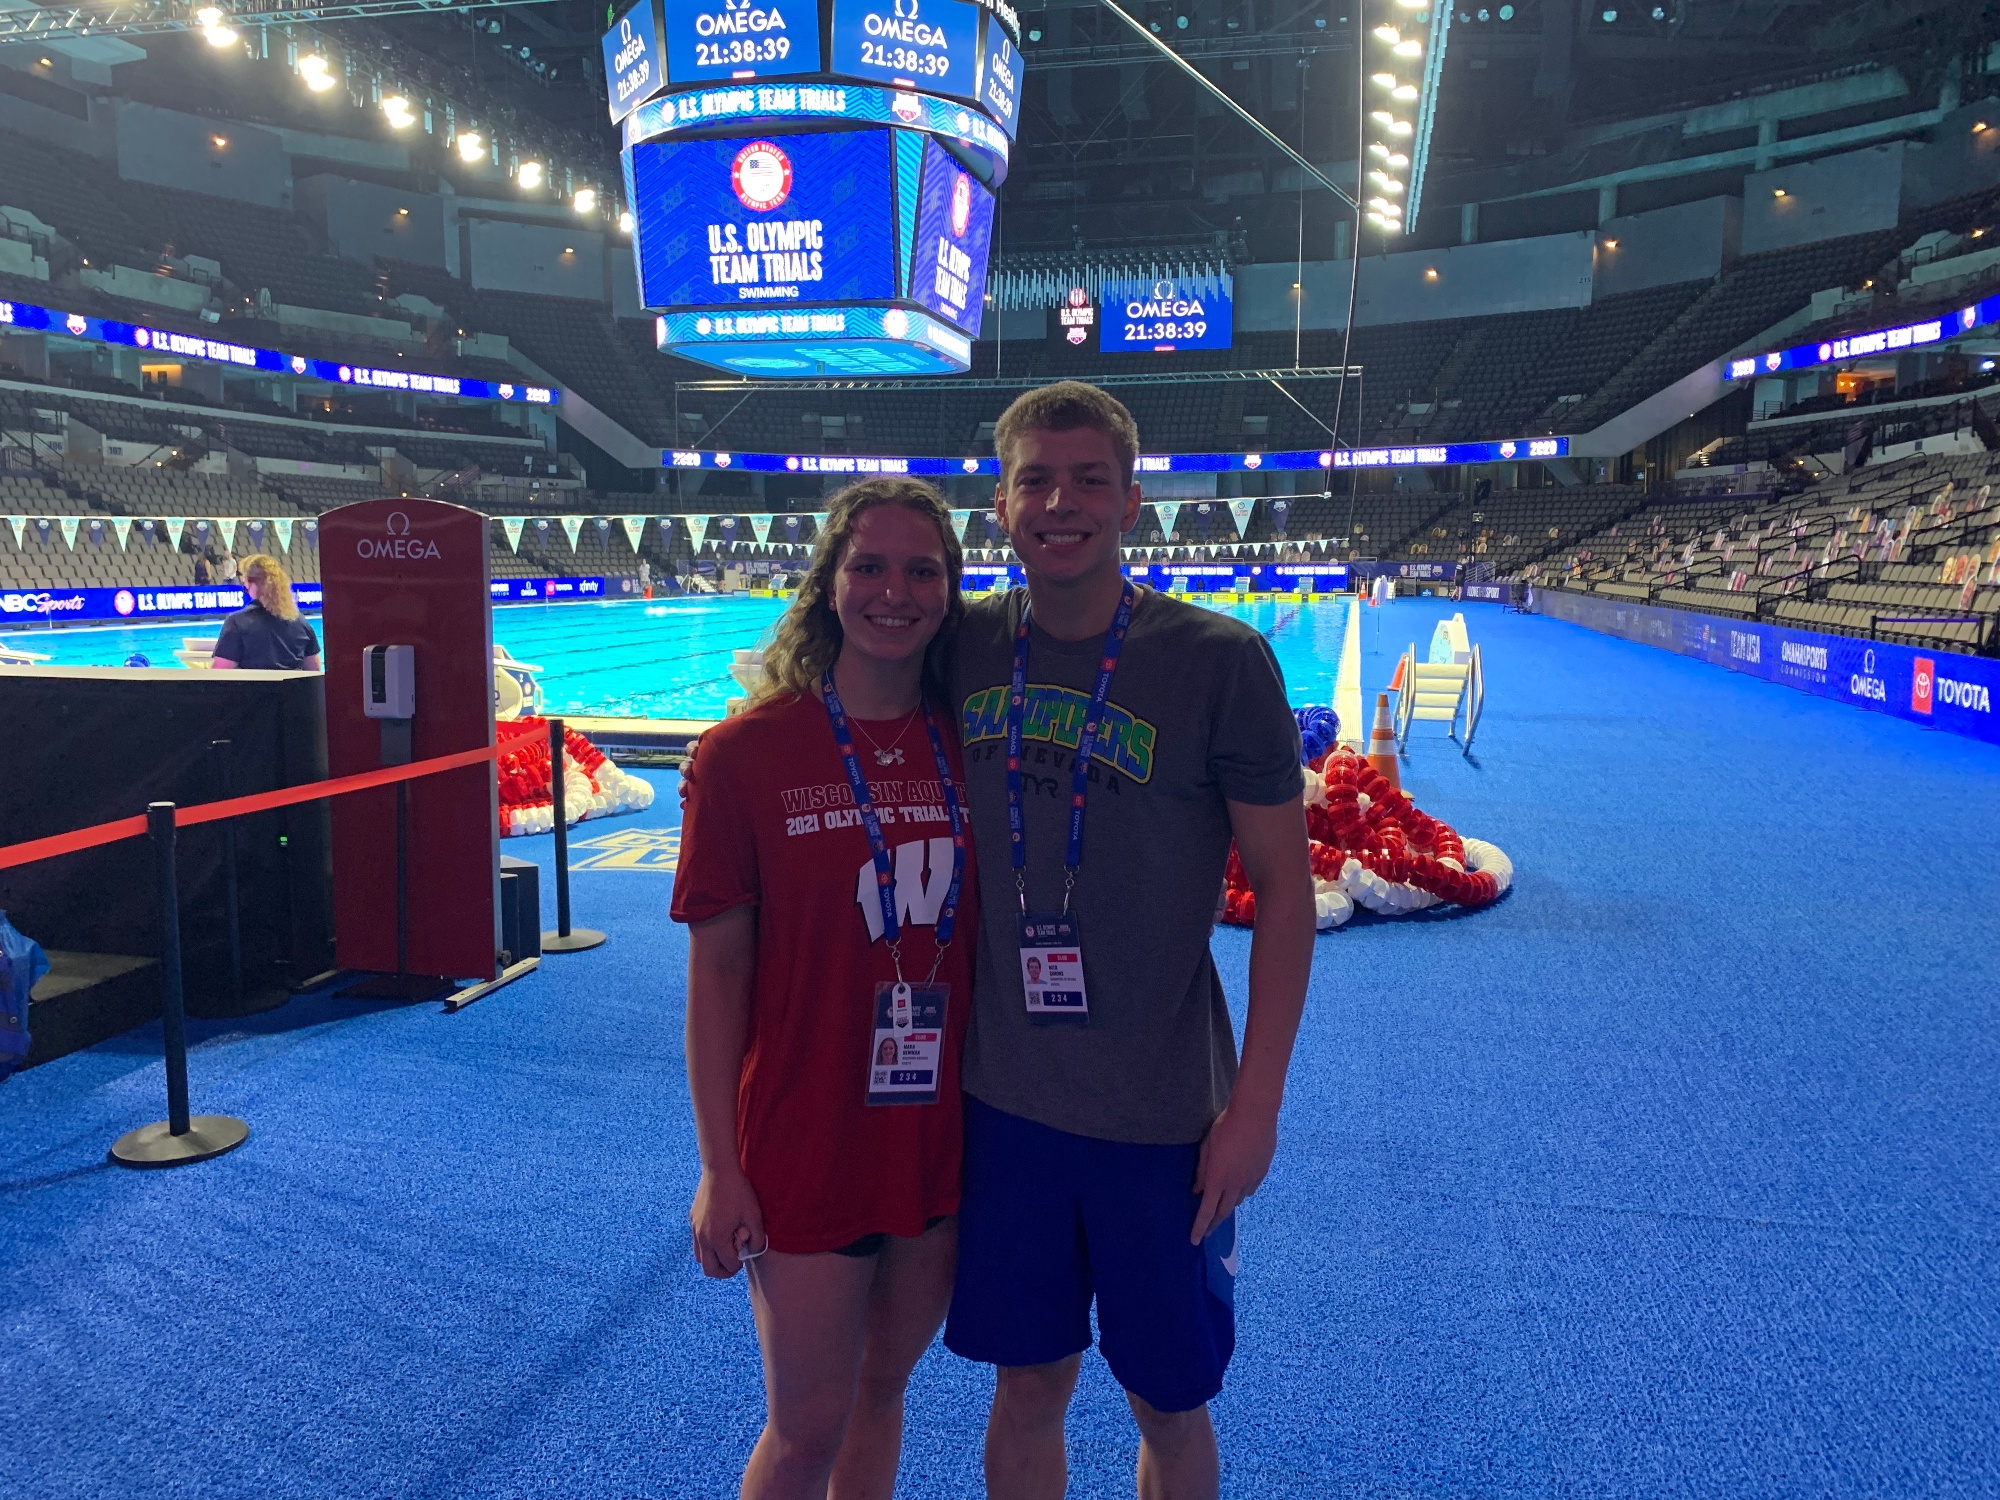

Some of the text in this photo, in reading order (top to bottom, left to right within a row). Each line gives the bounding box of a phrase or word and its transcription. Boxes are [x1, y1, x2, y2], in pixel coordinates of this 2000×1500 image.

[696, 8, 786, 36] OMEGA
[864, 14, 948, 49] OMEGA
[614, 34, 646, 74] OMEGA
[696, 37, 790, 66] 21:38:39
[861, 42, 950, 77] 21:38:39
[617, 60, 650, 102] 21:38:39
[992, 53, 1014, 94] OMEGA
[702, 90, 755, 116] OLYMPIC
[758, 88, 796, 111] TEAM
[799, 88, 846, 112] TRIALS
[988, 78, 1013, 118] 21:38:39
[738, 144, 784, 164] UNITED STATES
[740, 192, 786, 208] OLYMPIC TEAM
[708, 220, 823, 254] U.S. OLYMPIC
[710, 251, 823, 284] TEAM TRIALS
[738, 286, 799, 299] SWIMMING
[1126, 300, 1204, 318] OMEGA
[1124, 322, 1207, 340] 21:38:39
[170, 334, 206, 358] OLYMPIC
[207, 340, 230, 360] TEAM
[108, 446, 122, 455] 107
[802, 457, 818, 472] U.S.
[820, 458, 854, 472] OLYMPIC
[856, 458, 879, 472] TEAM
[1334, 450, 1351, 467] U.S.
[1390, 448, 1416, 464] TEAM
[1416, 446, 1446, 463] TRIALS
[357, 538, 441, 560] OMEGA
[138, 590, 244, 611] U.S. OLYMPIC TEAM TRIALS
[579, 580, 598, 593] xfinity
[35, 592, 86, 616] Sports
[1747, 633, 1760, 664] USA
[519, 674, 524, 682] 2
[1096, 672, 1110, 702] TOYOTA
[1851, 674, 1886, 702] OMEGA
[1937, 676, 1990, 714] TOYOTA
[1010, 724, 1018, 755] TOYOTA
[848, 757, 861, 786] TOYOTA
[781, 781, 902, 814] WISCOSIN
[786, 814, 820, 836] 2021
[898, 806, 950, 823] TRIAL
[952, 804, 962, 832] TOYOTA
[1072, 810, 1081, 841] TOYOTA
[856, 837, 956, 944] W
[884, 886, 893, 918] TOYOTA
[1051, 994, 1056, 1002] 2
[1058, 994, 1062, 1002] 3
[899, 1073, 904, 1081] 2
[906, 1073, 910, 1081] 3
